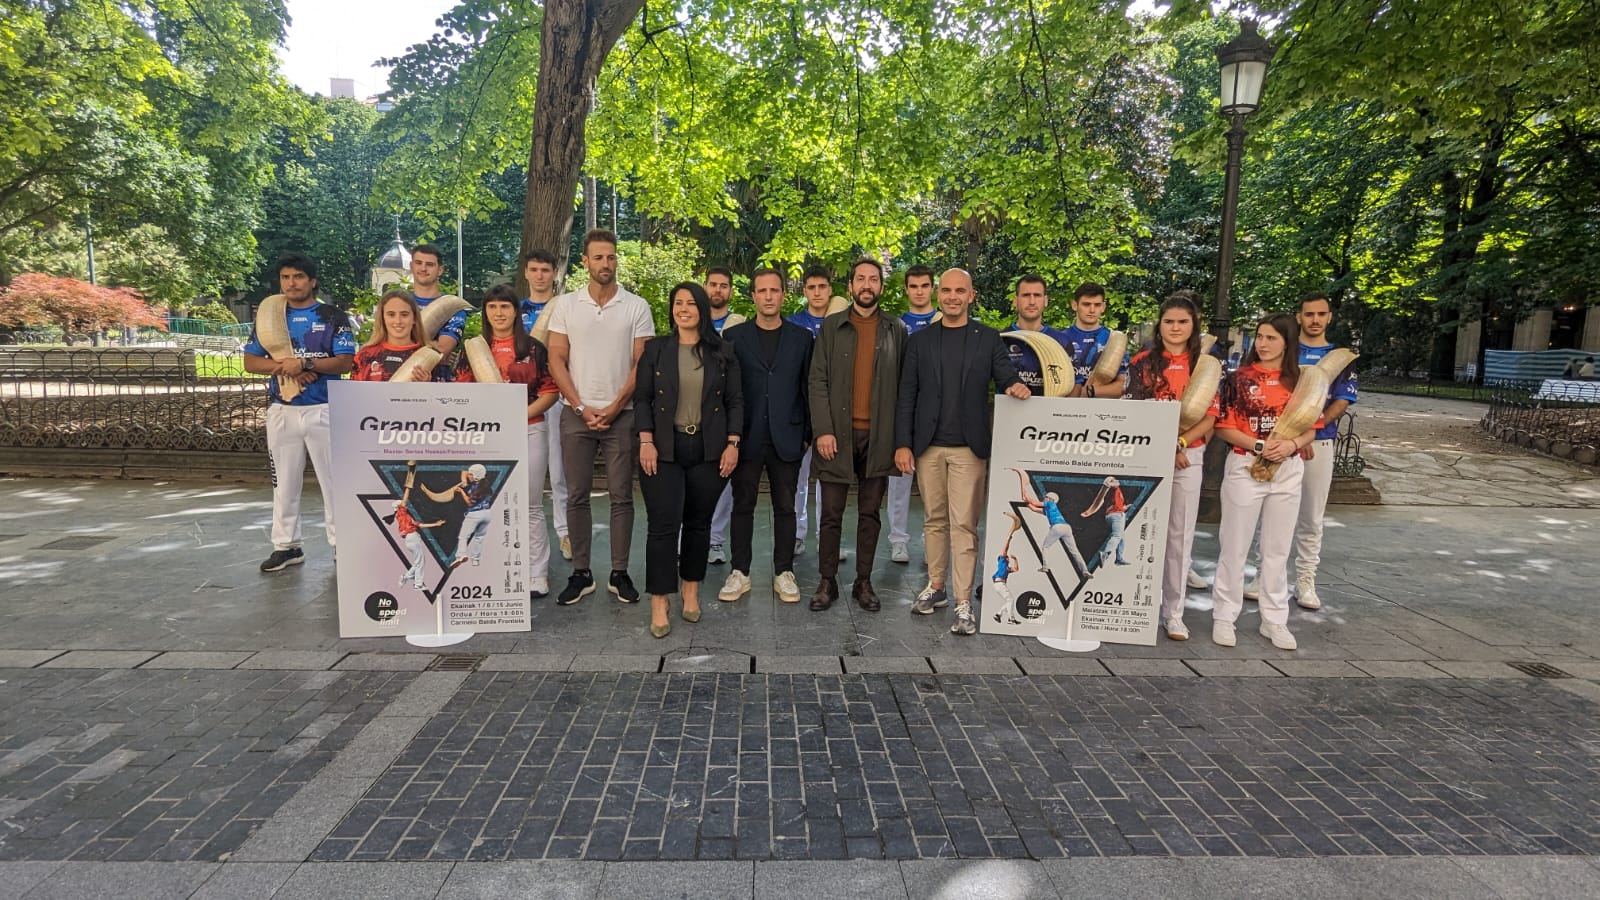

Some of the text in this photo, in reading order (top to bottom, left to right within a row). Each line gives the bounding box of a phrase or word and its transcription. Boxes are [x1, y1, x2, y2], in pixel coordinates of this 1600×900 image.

[360, 416, 501, 432] Grand Slam
[378, 430, 485, 445] Donostia
[1020, 426, 1151, 445] Grand Slam
[1034, 439, 1134, 457] Donostia
[451, 586, 492, 599] 2024
[1083, 591, 1123, 606] 2024
[379, 608, 407, 616] speed
